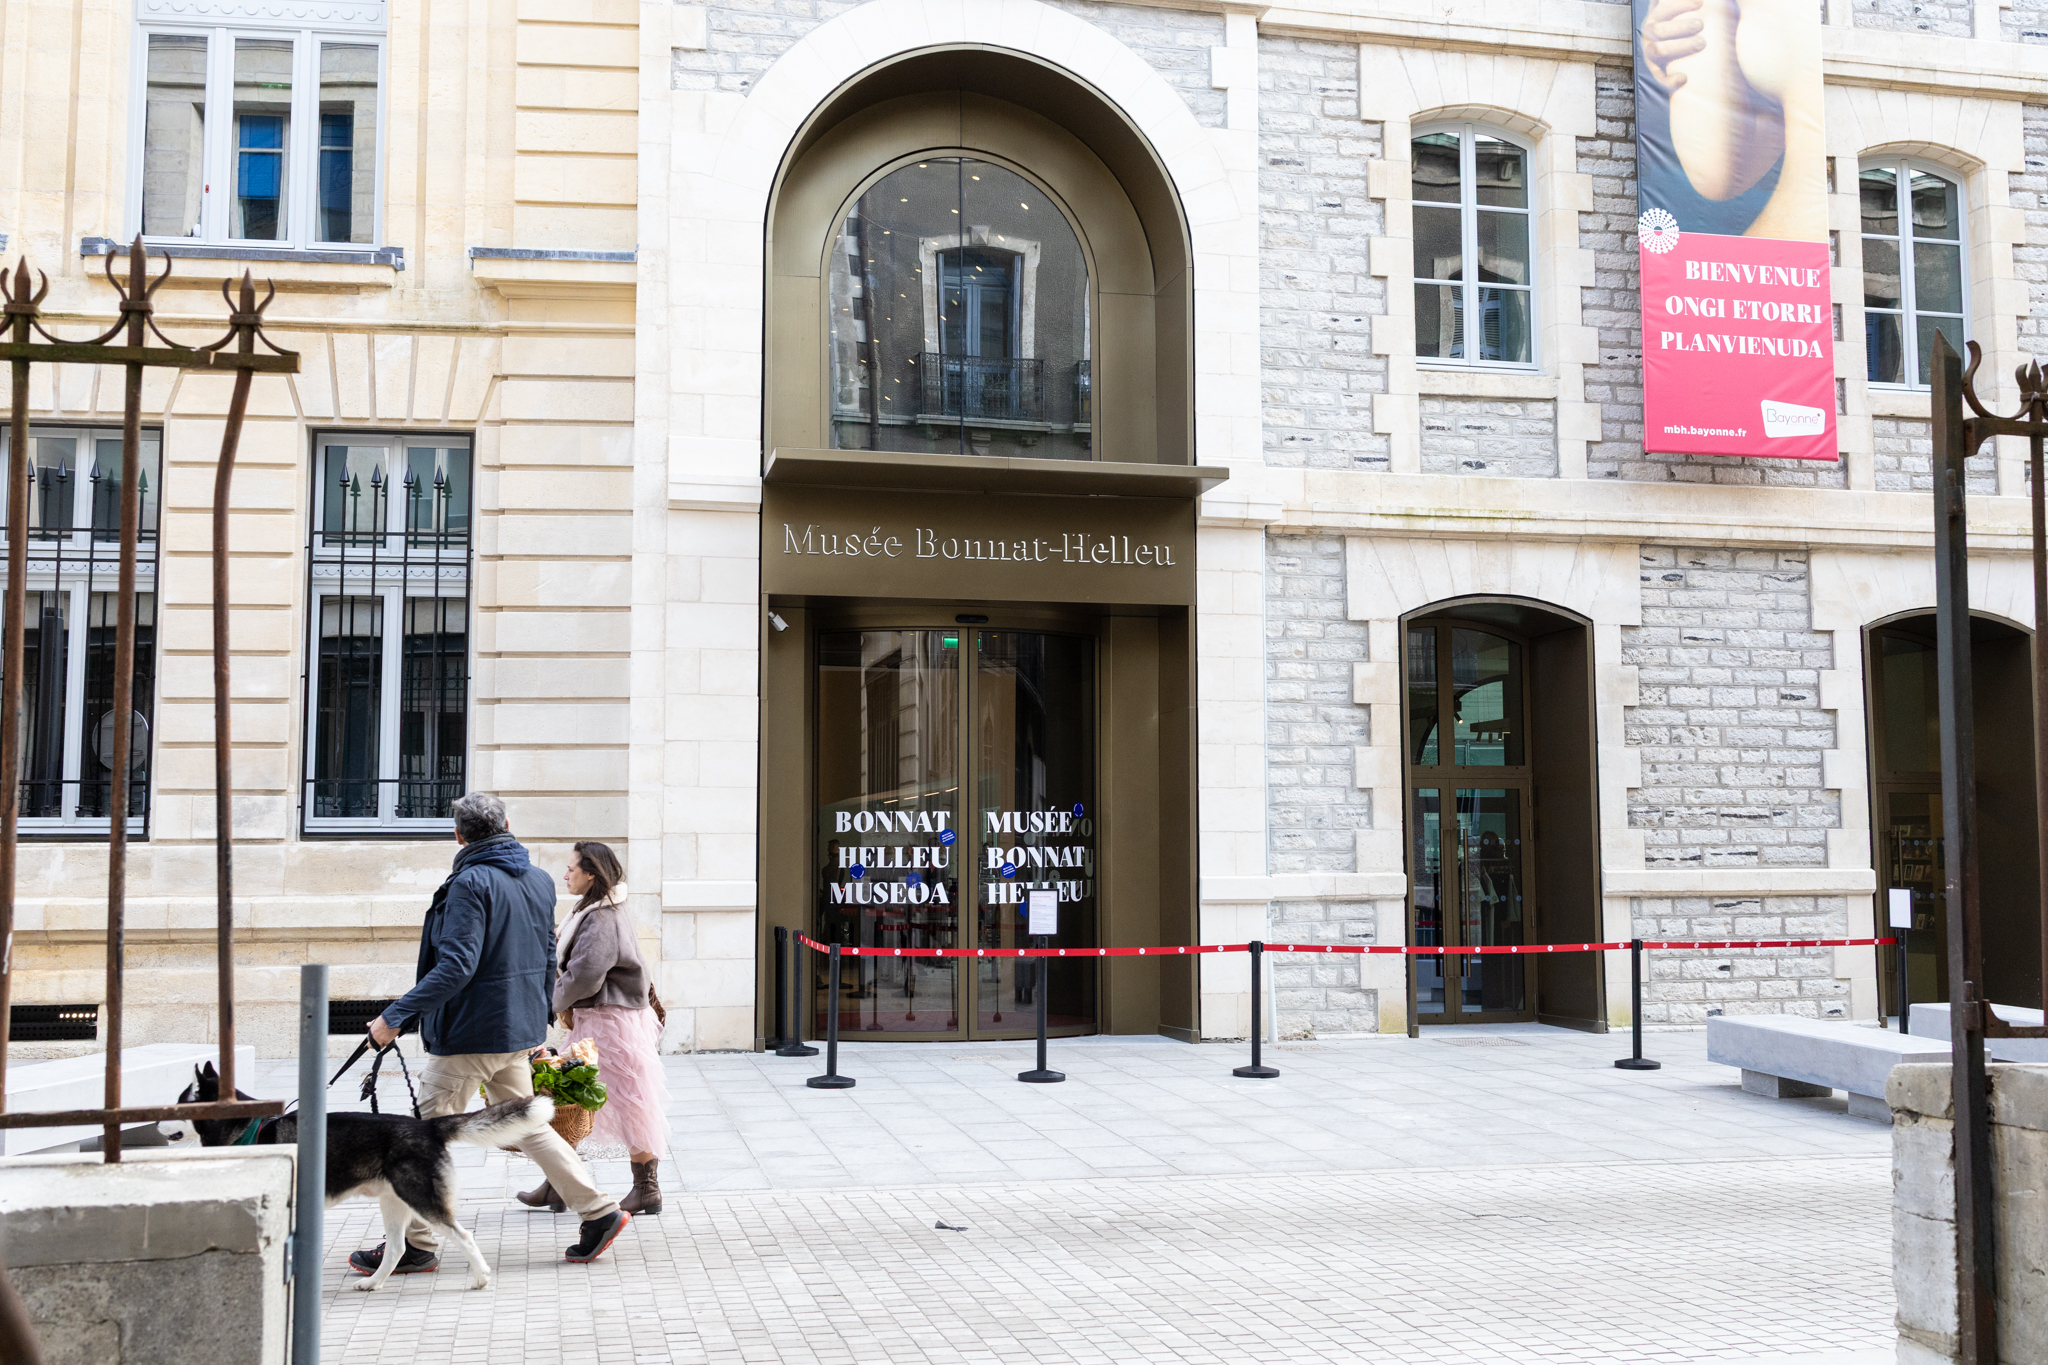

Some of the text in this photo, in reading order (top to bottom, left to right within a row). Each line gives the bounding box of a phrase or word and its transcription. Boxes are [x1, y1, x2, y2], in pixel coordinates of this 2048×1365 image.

[1685, 260, 1821, 288] BIENVENUE
[1665, 295, 1822, 324] ONGI ETORRI
[1660, 331, 1824, 358] PLANVIENUDA
[1766, 408, 1819, 426] Bayonne
[1664, 424, 1747, 438] mbh.bayonne.fr
[783, 523, 1176, 566] Musée Bonnat-Helleu
[835, 810, 950, 833] BONNAT
[987, 805, 1072, 833] MUSÉE
[838, 846, 950, 869] HELLEU
[987, 845, 1085, 869] BONNAT
[830, 881, 950, 904] MUSEOA
